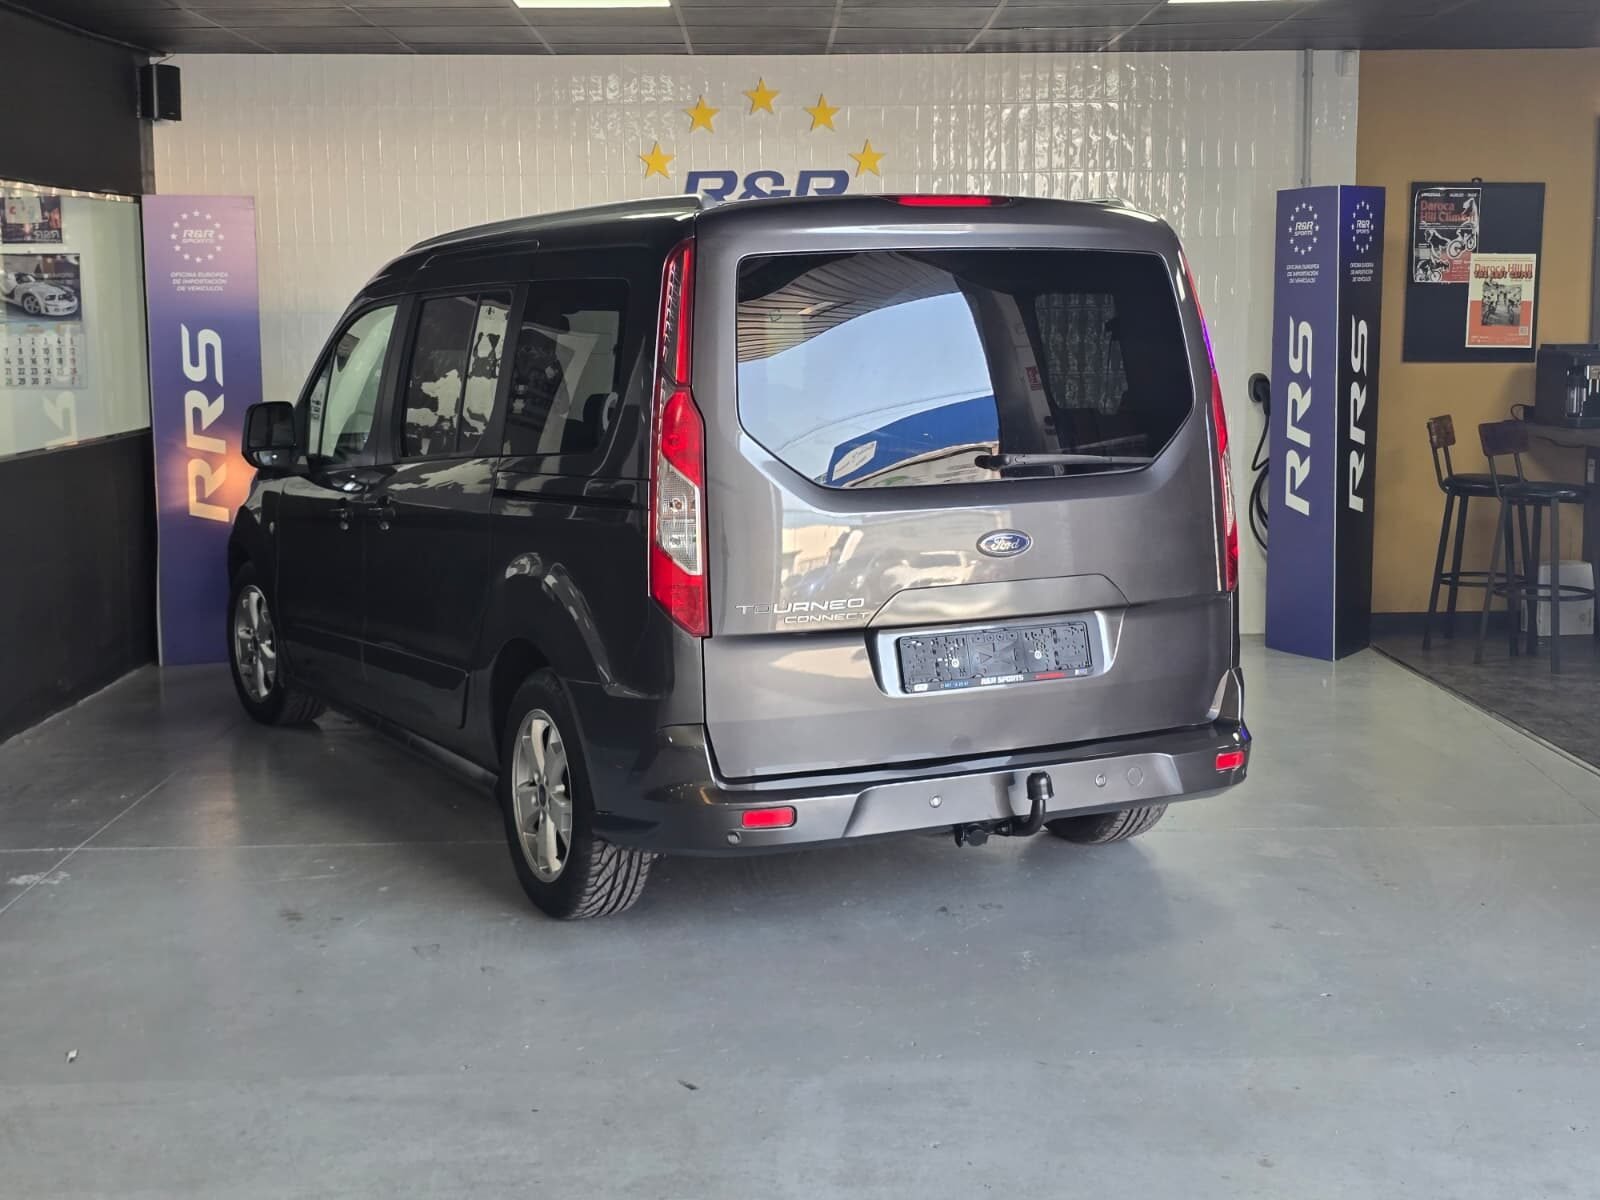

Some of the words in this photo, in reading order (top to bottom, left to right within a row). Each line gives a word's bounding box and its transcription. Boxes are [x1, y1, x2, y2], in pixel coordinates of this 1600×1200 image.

[684, 170, 850, 201] R&R
[183, 229, 215, 238] R&R
[1474, 263, 1506, 273] Daroca
[1284, 315, 1313, 516] RRS
[1348, 314, 1369, 513] RRS
[181, 322, 230, 523] RRS
[991, 535, 1021, 551] Ford
[735, 598, 865, 615] TOURNEO
[784, 611, 871, 624] CONNECT
[998, 674, 1024, 684] SPORTS
